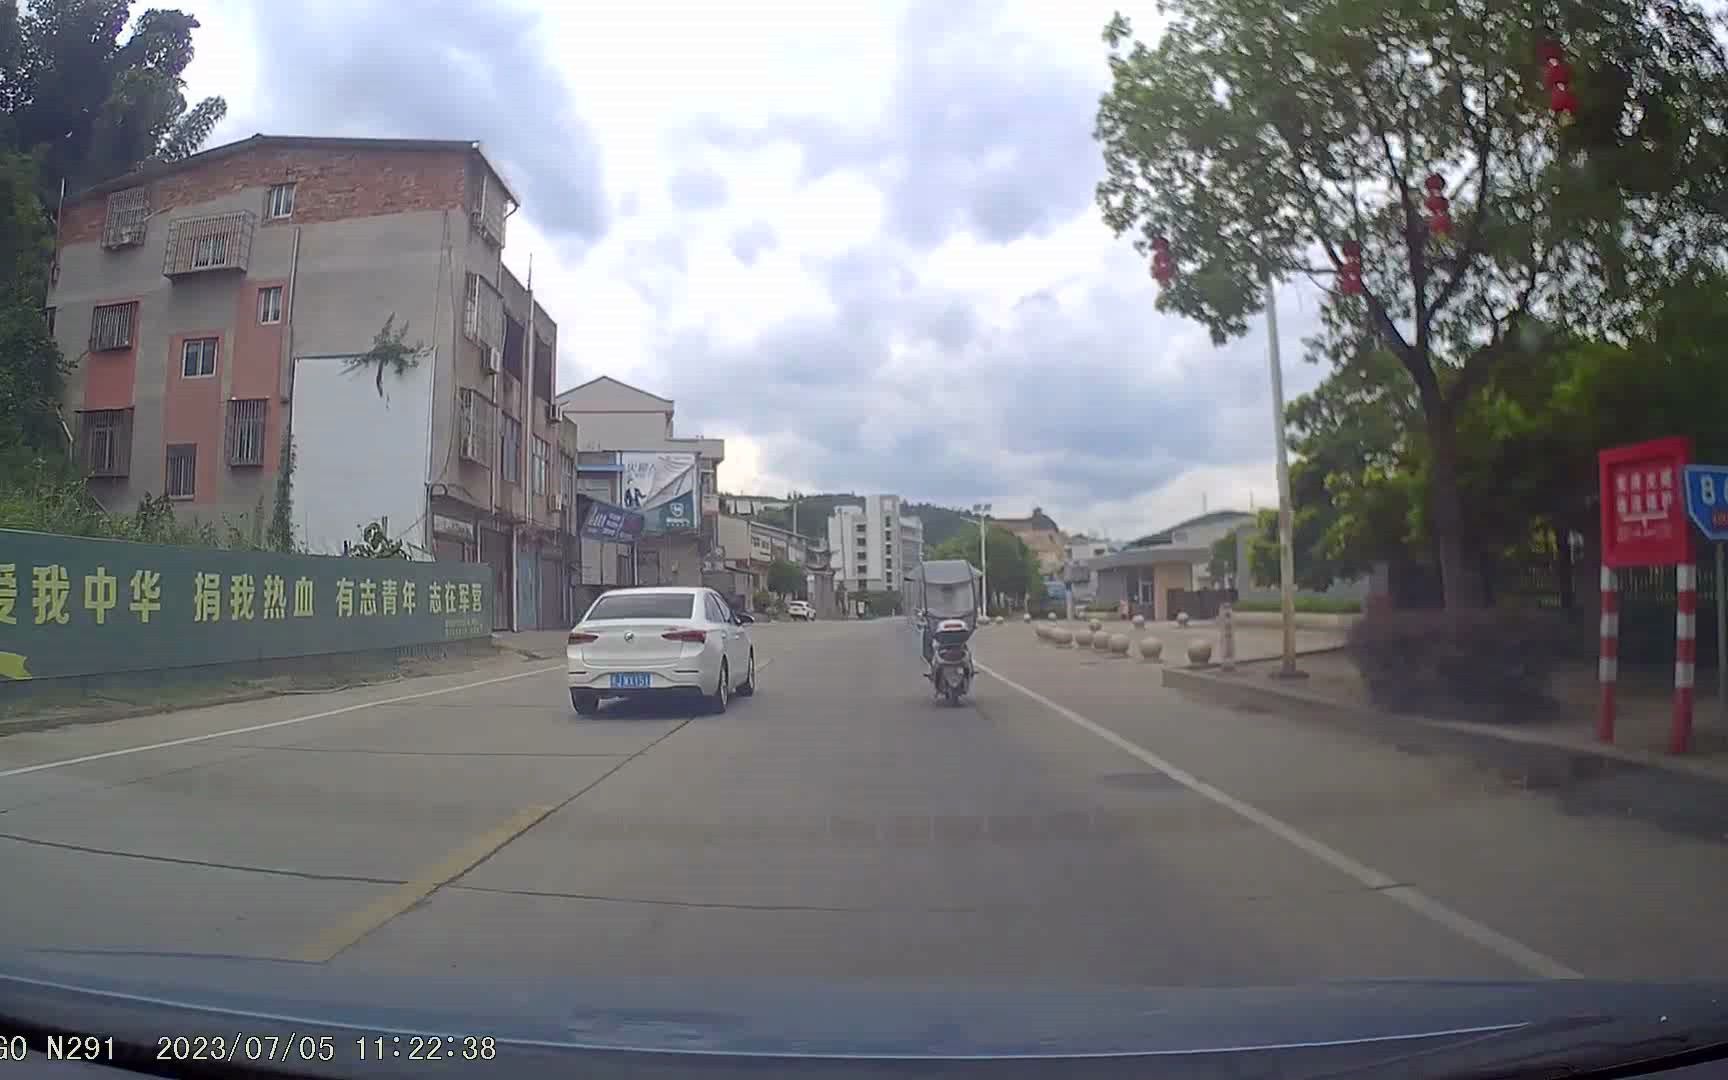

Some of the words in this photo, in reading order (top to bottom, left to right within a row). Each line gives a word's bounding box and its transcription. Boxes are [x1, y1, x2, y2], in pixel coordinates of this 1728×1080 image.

[1700, 474, 1728, 505] 8
[194, 571, 315, 622] 捐我热血
[336, 577, 417, 617] 有志青年
[429, 580, 482, 615] 志在军营
